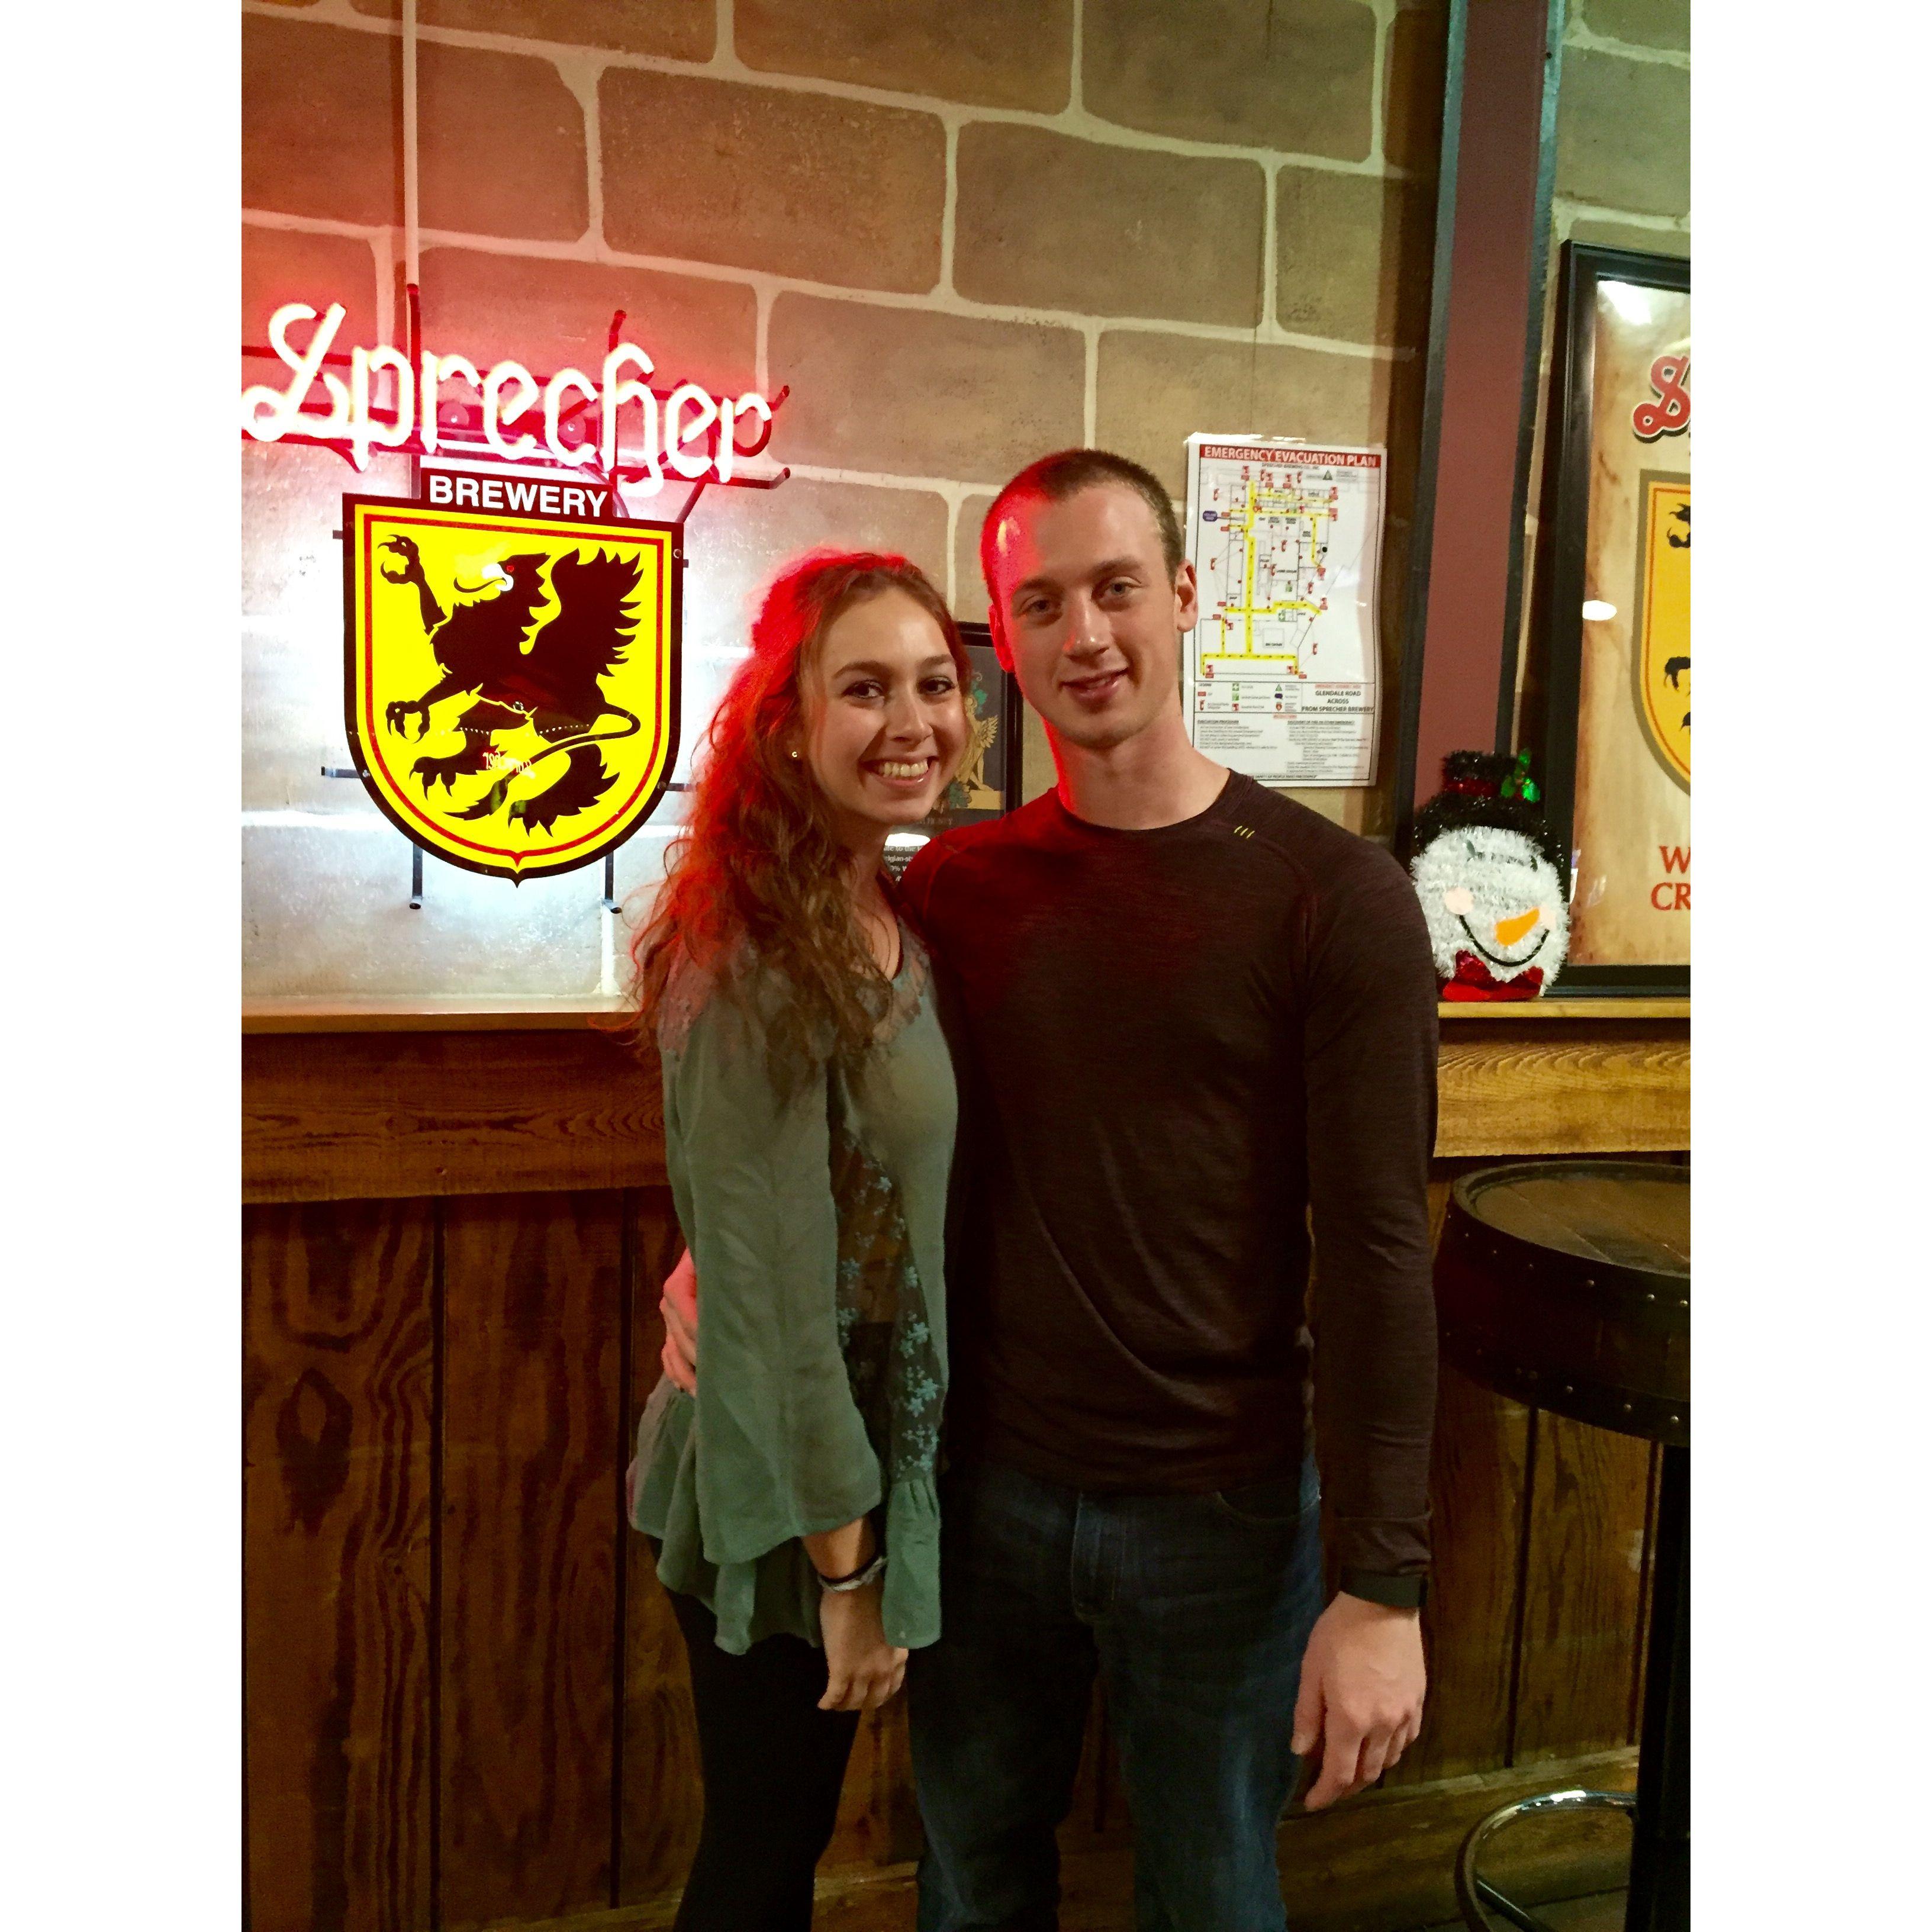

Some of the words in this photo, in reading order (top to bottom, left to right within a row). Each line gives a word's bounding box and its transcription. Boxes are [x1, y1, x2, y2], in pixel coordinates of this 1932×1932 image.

[242, 302, 772, 496] Sprecher
[1204, 446, 1275, 462] EMERGENCY
[1275, 450, 1345, 465] EVACUATION
[1347, 455, 1376, 467] PLAN
[429, 475, 608, 516] BREWERY
[1651, 882, 1690, 910] CR
